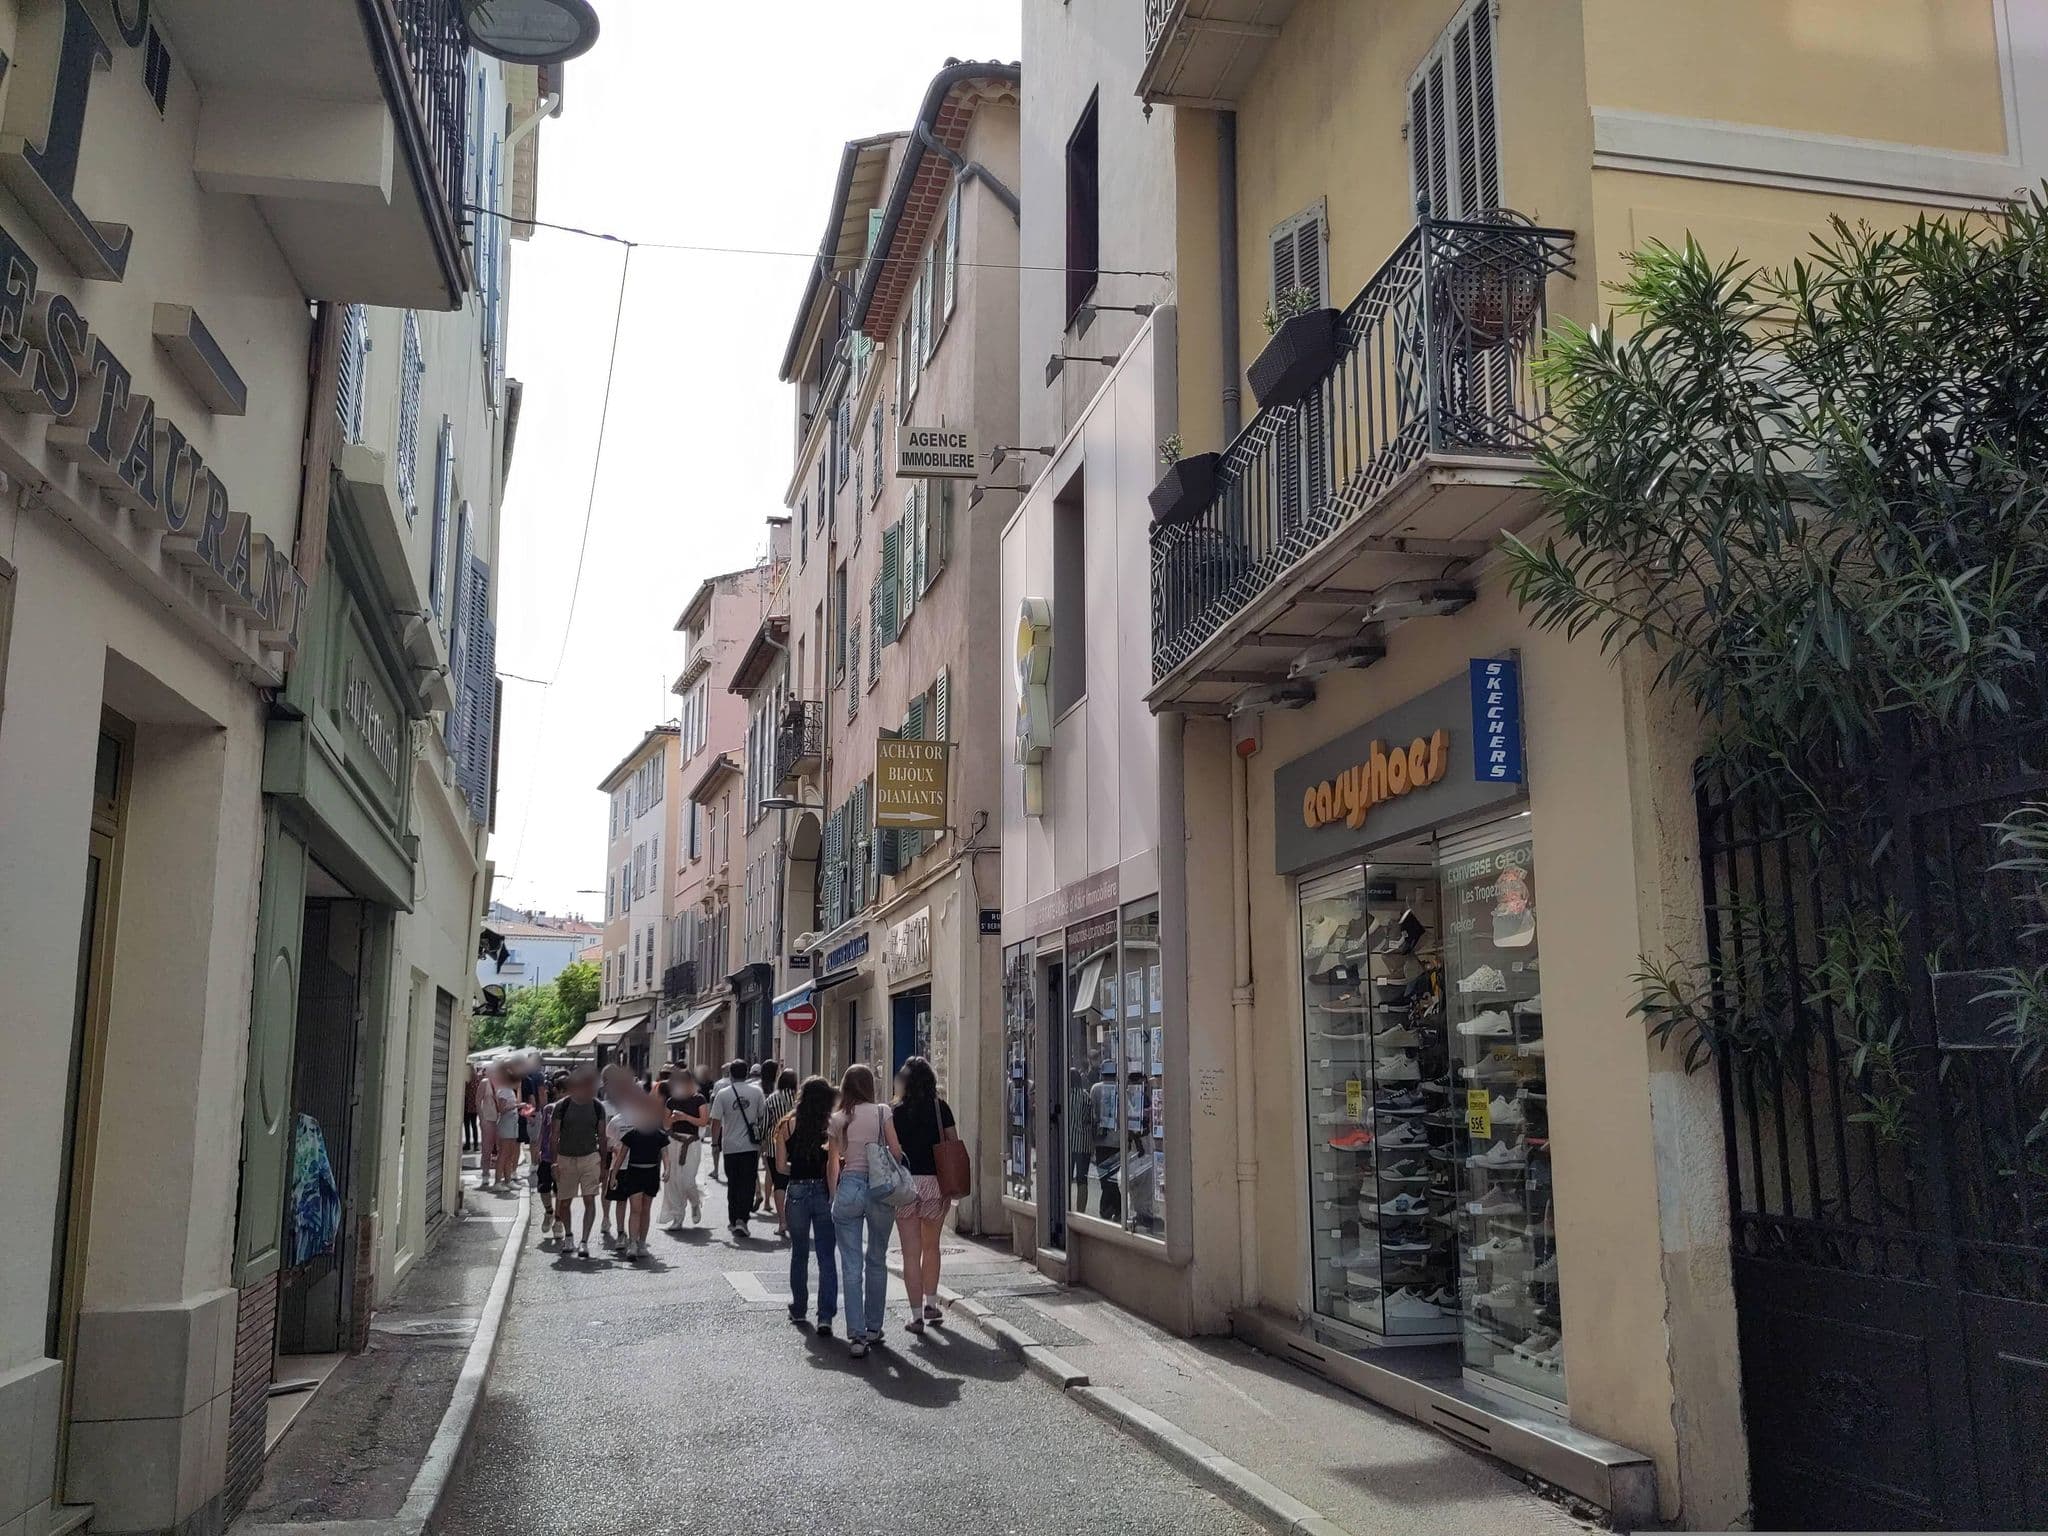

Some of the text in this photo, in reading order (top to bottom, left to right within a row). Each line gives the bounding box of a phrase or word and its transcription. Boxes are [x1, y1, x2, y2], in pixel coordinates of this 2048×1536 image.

[909, 432, 967, 448] AGENCE
[901, 451, 975, 468] IMMOBILIERE
[1485, 663, 1507, 778] SKECHERS
[879, 744, 943, 760] ACHAT OR
[889, 766, 934, 782] BIJOUX
[1303, 728, 1449, 829] easyshoes
[879, 788, 944, 805] DIAMANTS
[1448, 857, 1492, 883] CONVERSE
[1461, 890, 1474, 904] Les
[1471, 1116, 1484, 1130] 55€
